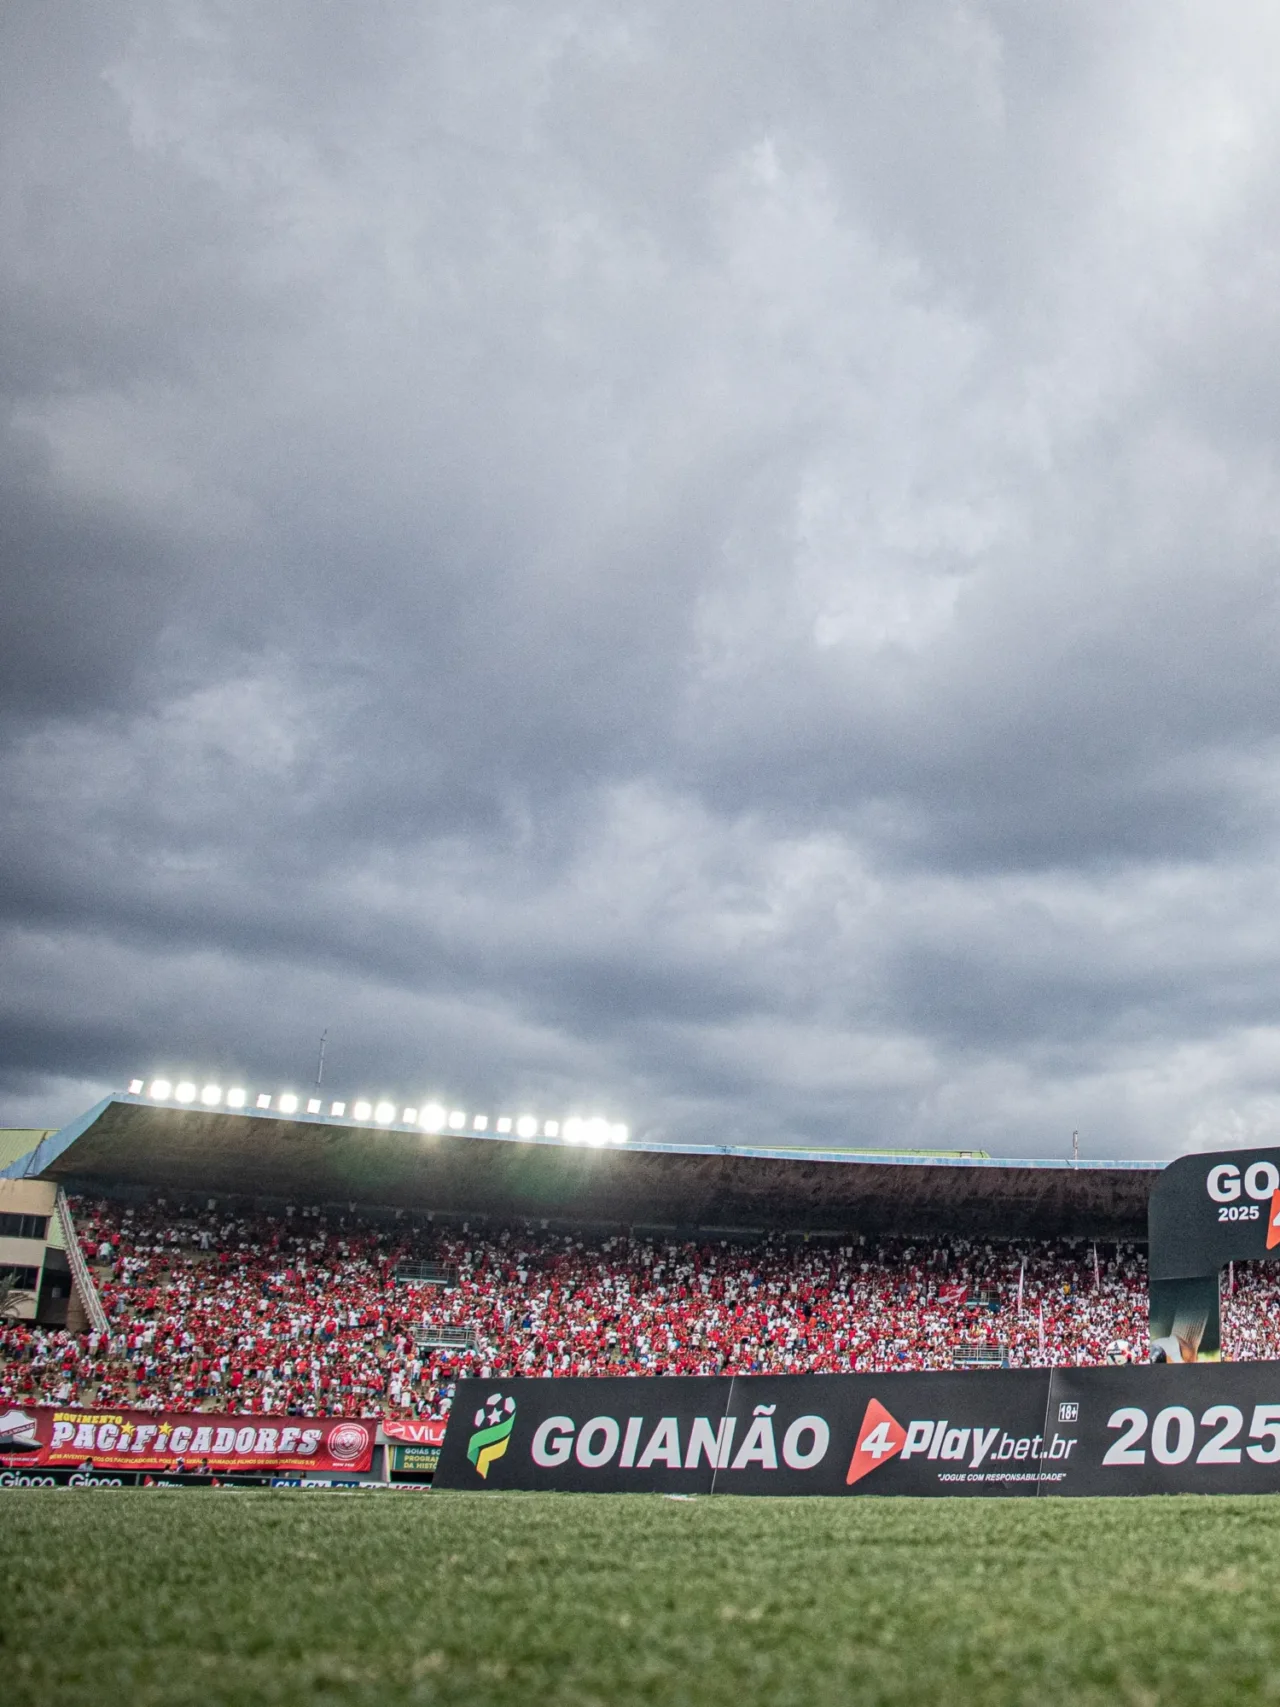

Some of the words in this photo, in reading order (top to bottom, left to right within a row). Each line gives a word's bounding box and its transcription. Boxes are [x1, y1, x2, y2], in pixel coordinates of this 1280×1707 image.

[1218, 1205, 1260, 1222] 2025
[1059, 1404, 1078, 1421] 18+
[531, 1403, 830, 1470] GOIANÃO
[967, 1473, 984, 1482] COM
